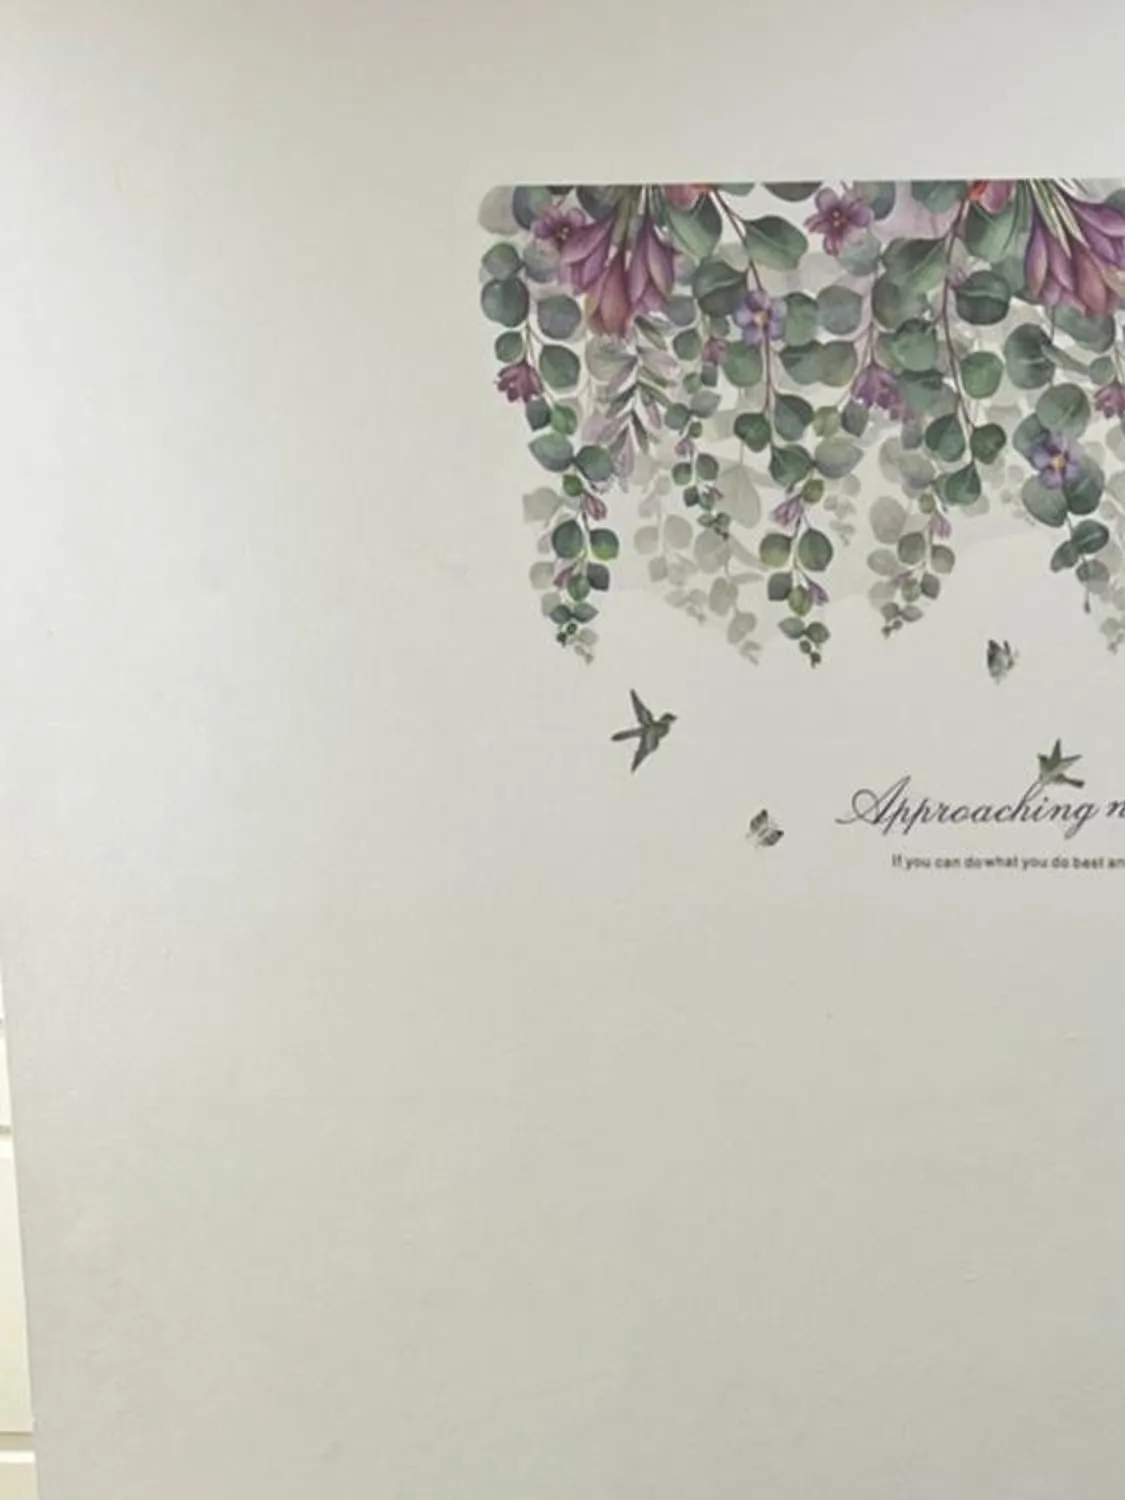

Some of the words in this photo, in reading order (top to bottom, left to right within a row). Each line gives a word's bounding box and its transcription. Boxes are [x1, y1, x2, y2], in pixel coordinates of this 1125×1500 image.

[834, 774, 1100, 841] Approaching
[890, 853, 903, 868] If
[905, 857, 932, 872] you
[933, 857, 962, 870] can
[1020, 857, 1049, 872] you
[1050, 855, 1070, 870] do
[1071, 856, 1104, 870] best
